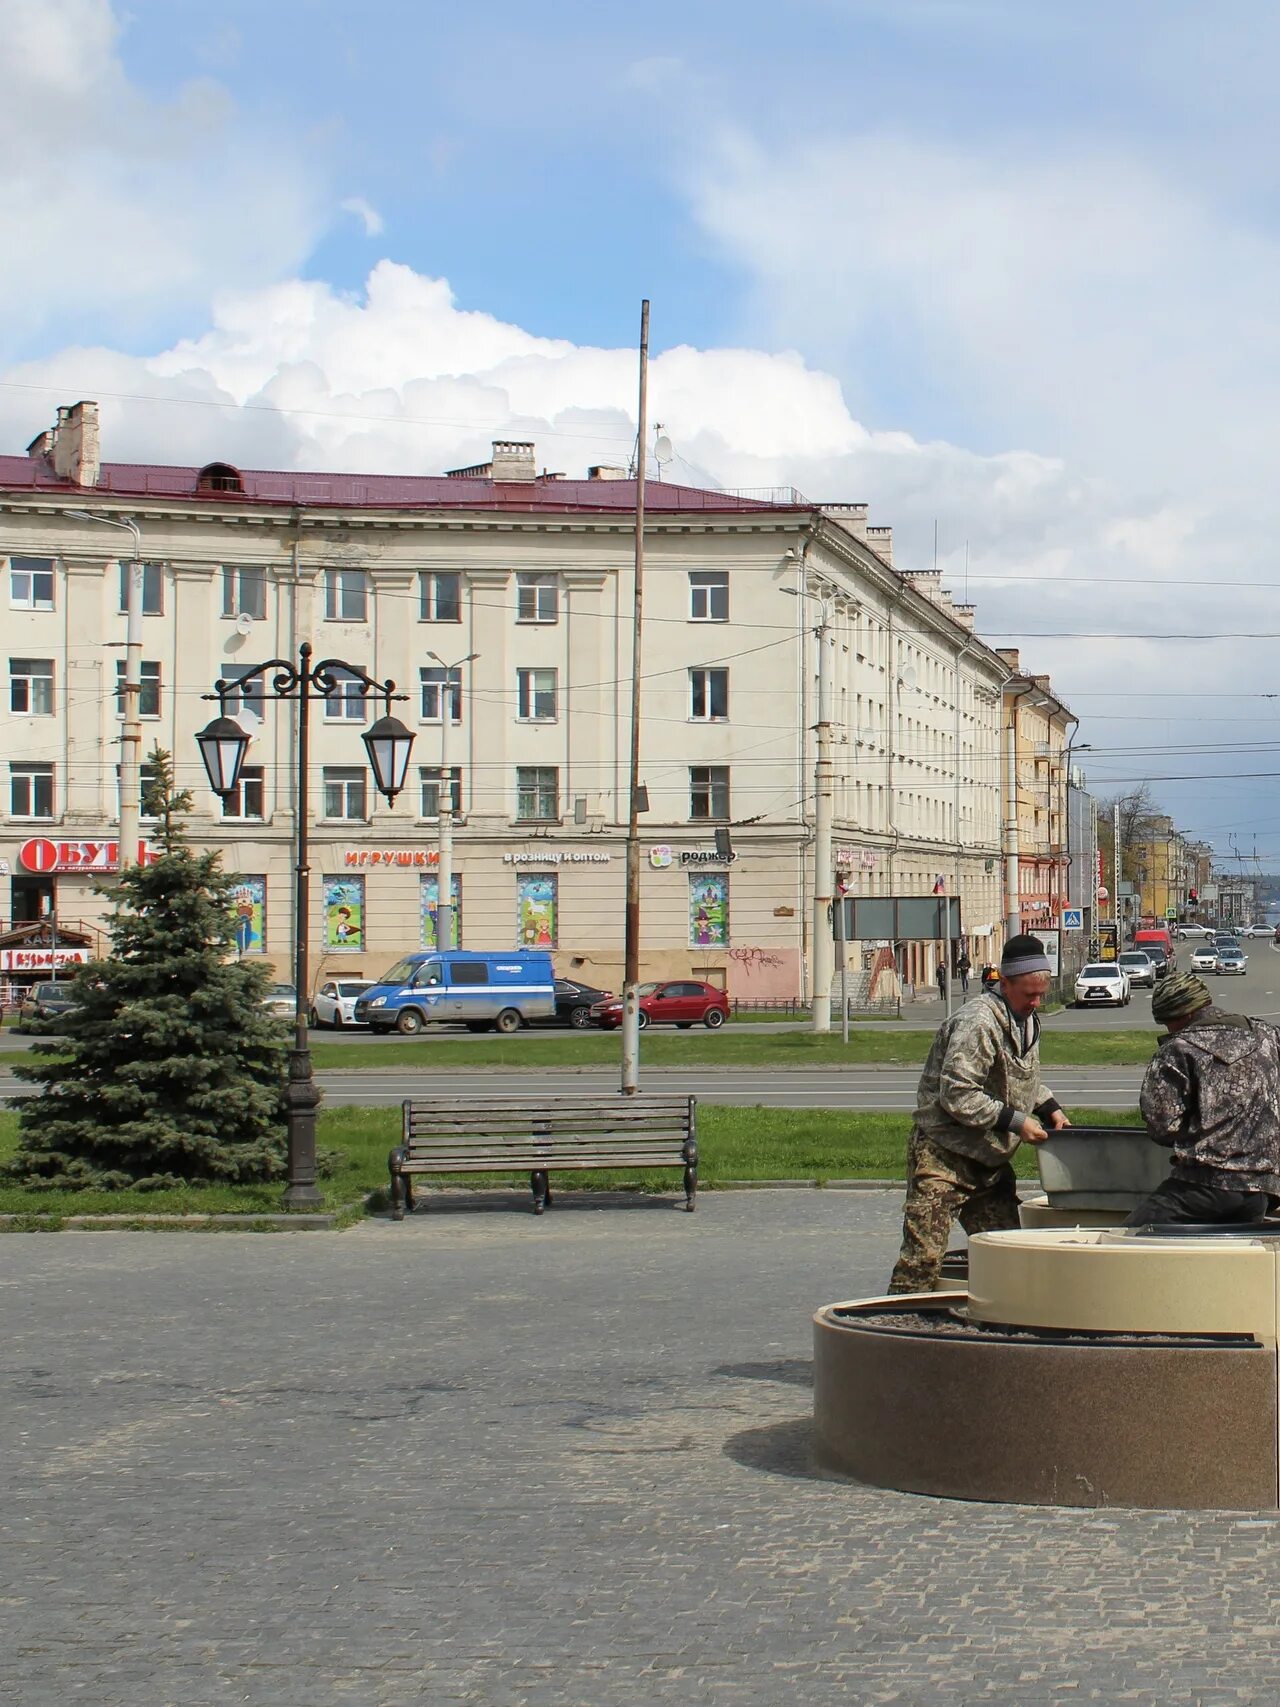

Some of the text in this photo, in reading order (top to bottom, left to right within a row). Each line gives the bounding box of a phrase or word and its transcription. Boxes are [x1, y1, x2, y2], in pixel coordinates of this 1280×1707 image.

[345, 850, 440, 865] ИГРУШКИ
[513, 853, 561, 864] розницу
[573, 852, 611, 861] оптом
[23, 935, 62, 944] КАФЕ
